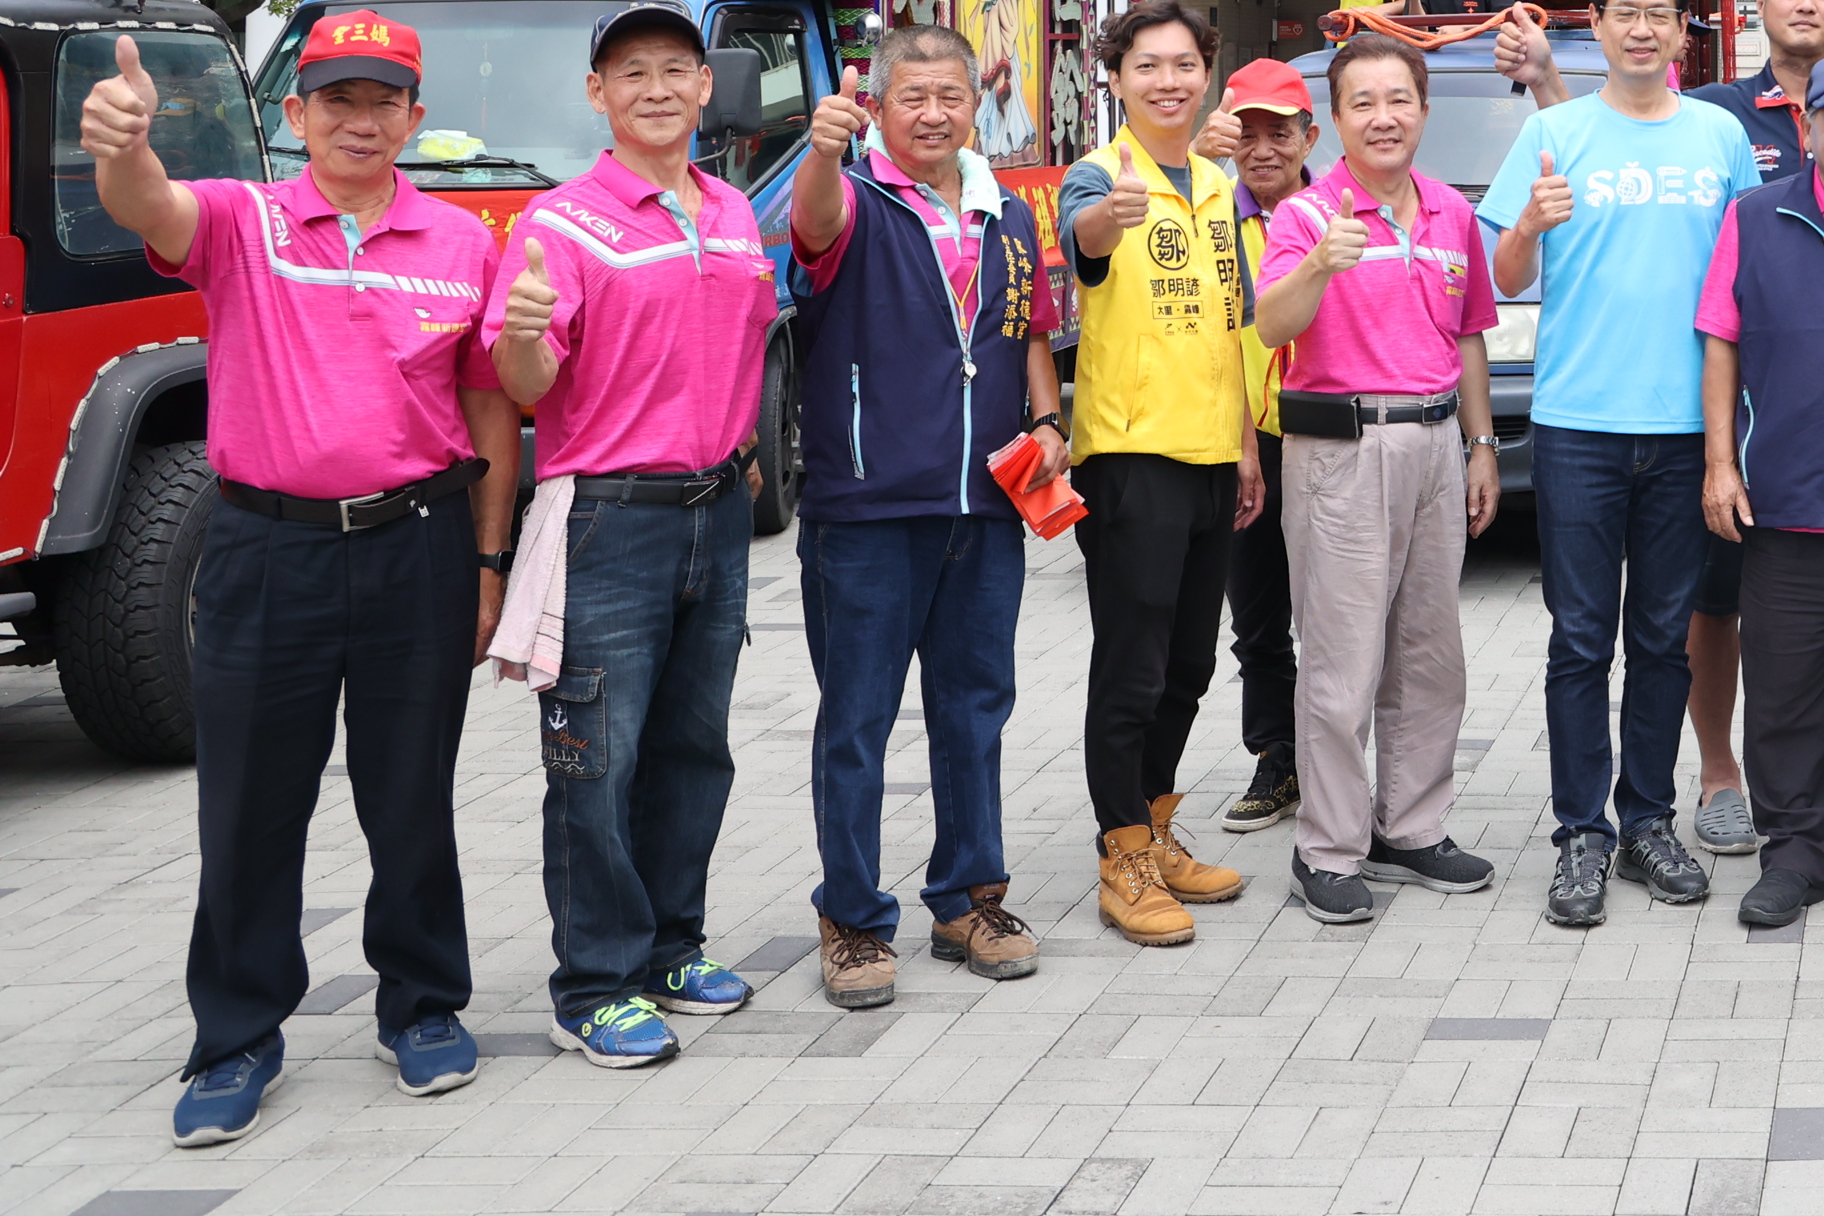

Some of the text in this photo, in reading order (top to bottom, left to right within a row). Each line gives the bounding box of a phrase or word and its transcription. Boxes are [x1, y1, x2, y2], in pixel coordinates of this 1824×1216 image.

[1155, 226, 1187, 264] 鄒
[1150, 278, 1201, 298] 鄒明諺
